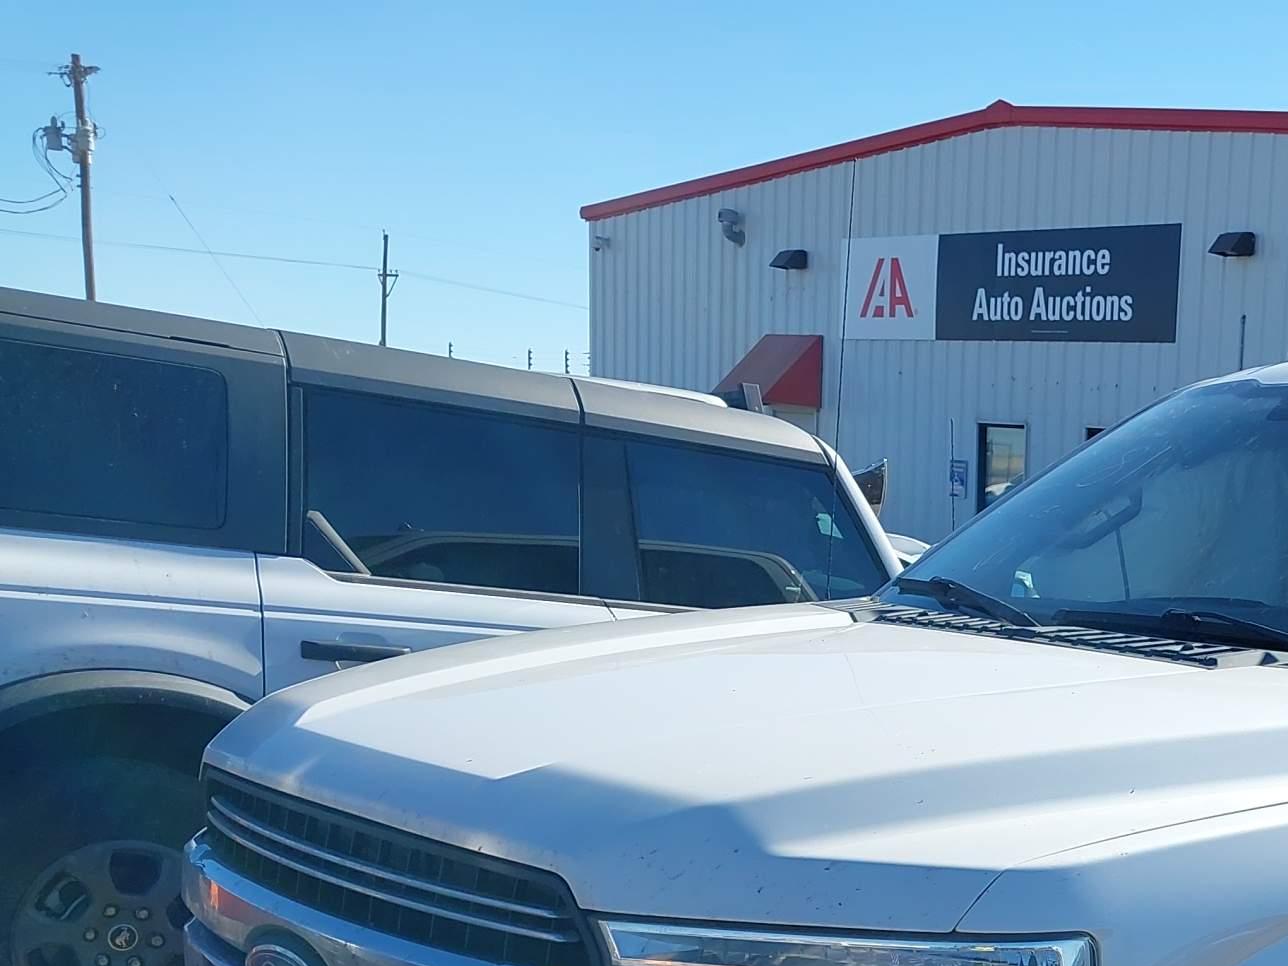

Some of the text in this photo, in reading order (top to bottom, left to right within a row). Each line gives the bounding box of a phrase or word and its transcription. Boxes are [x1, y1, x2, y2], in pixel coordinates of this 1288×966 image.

[996, 243, 1111, 277] Insurance
[971, 286, 1133, 322] Auto Auctions
